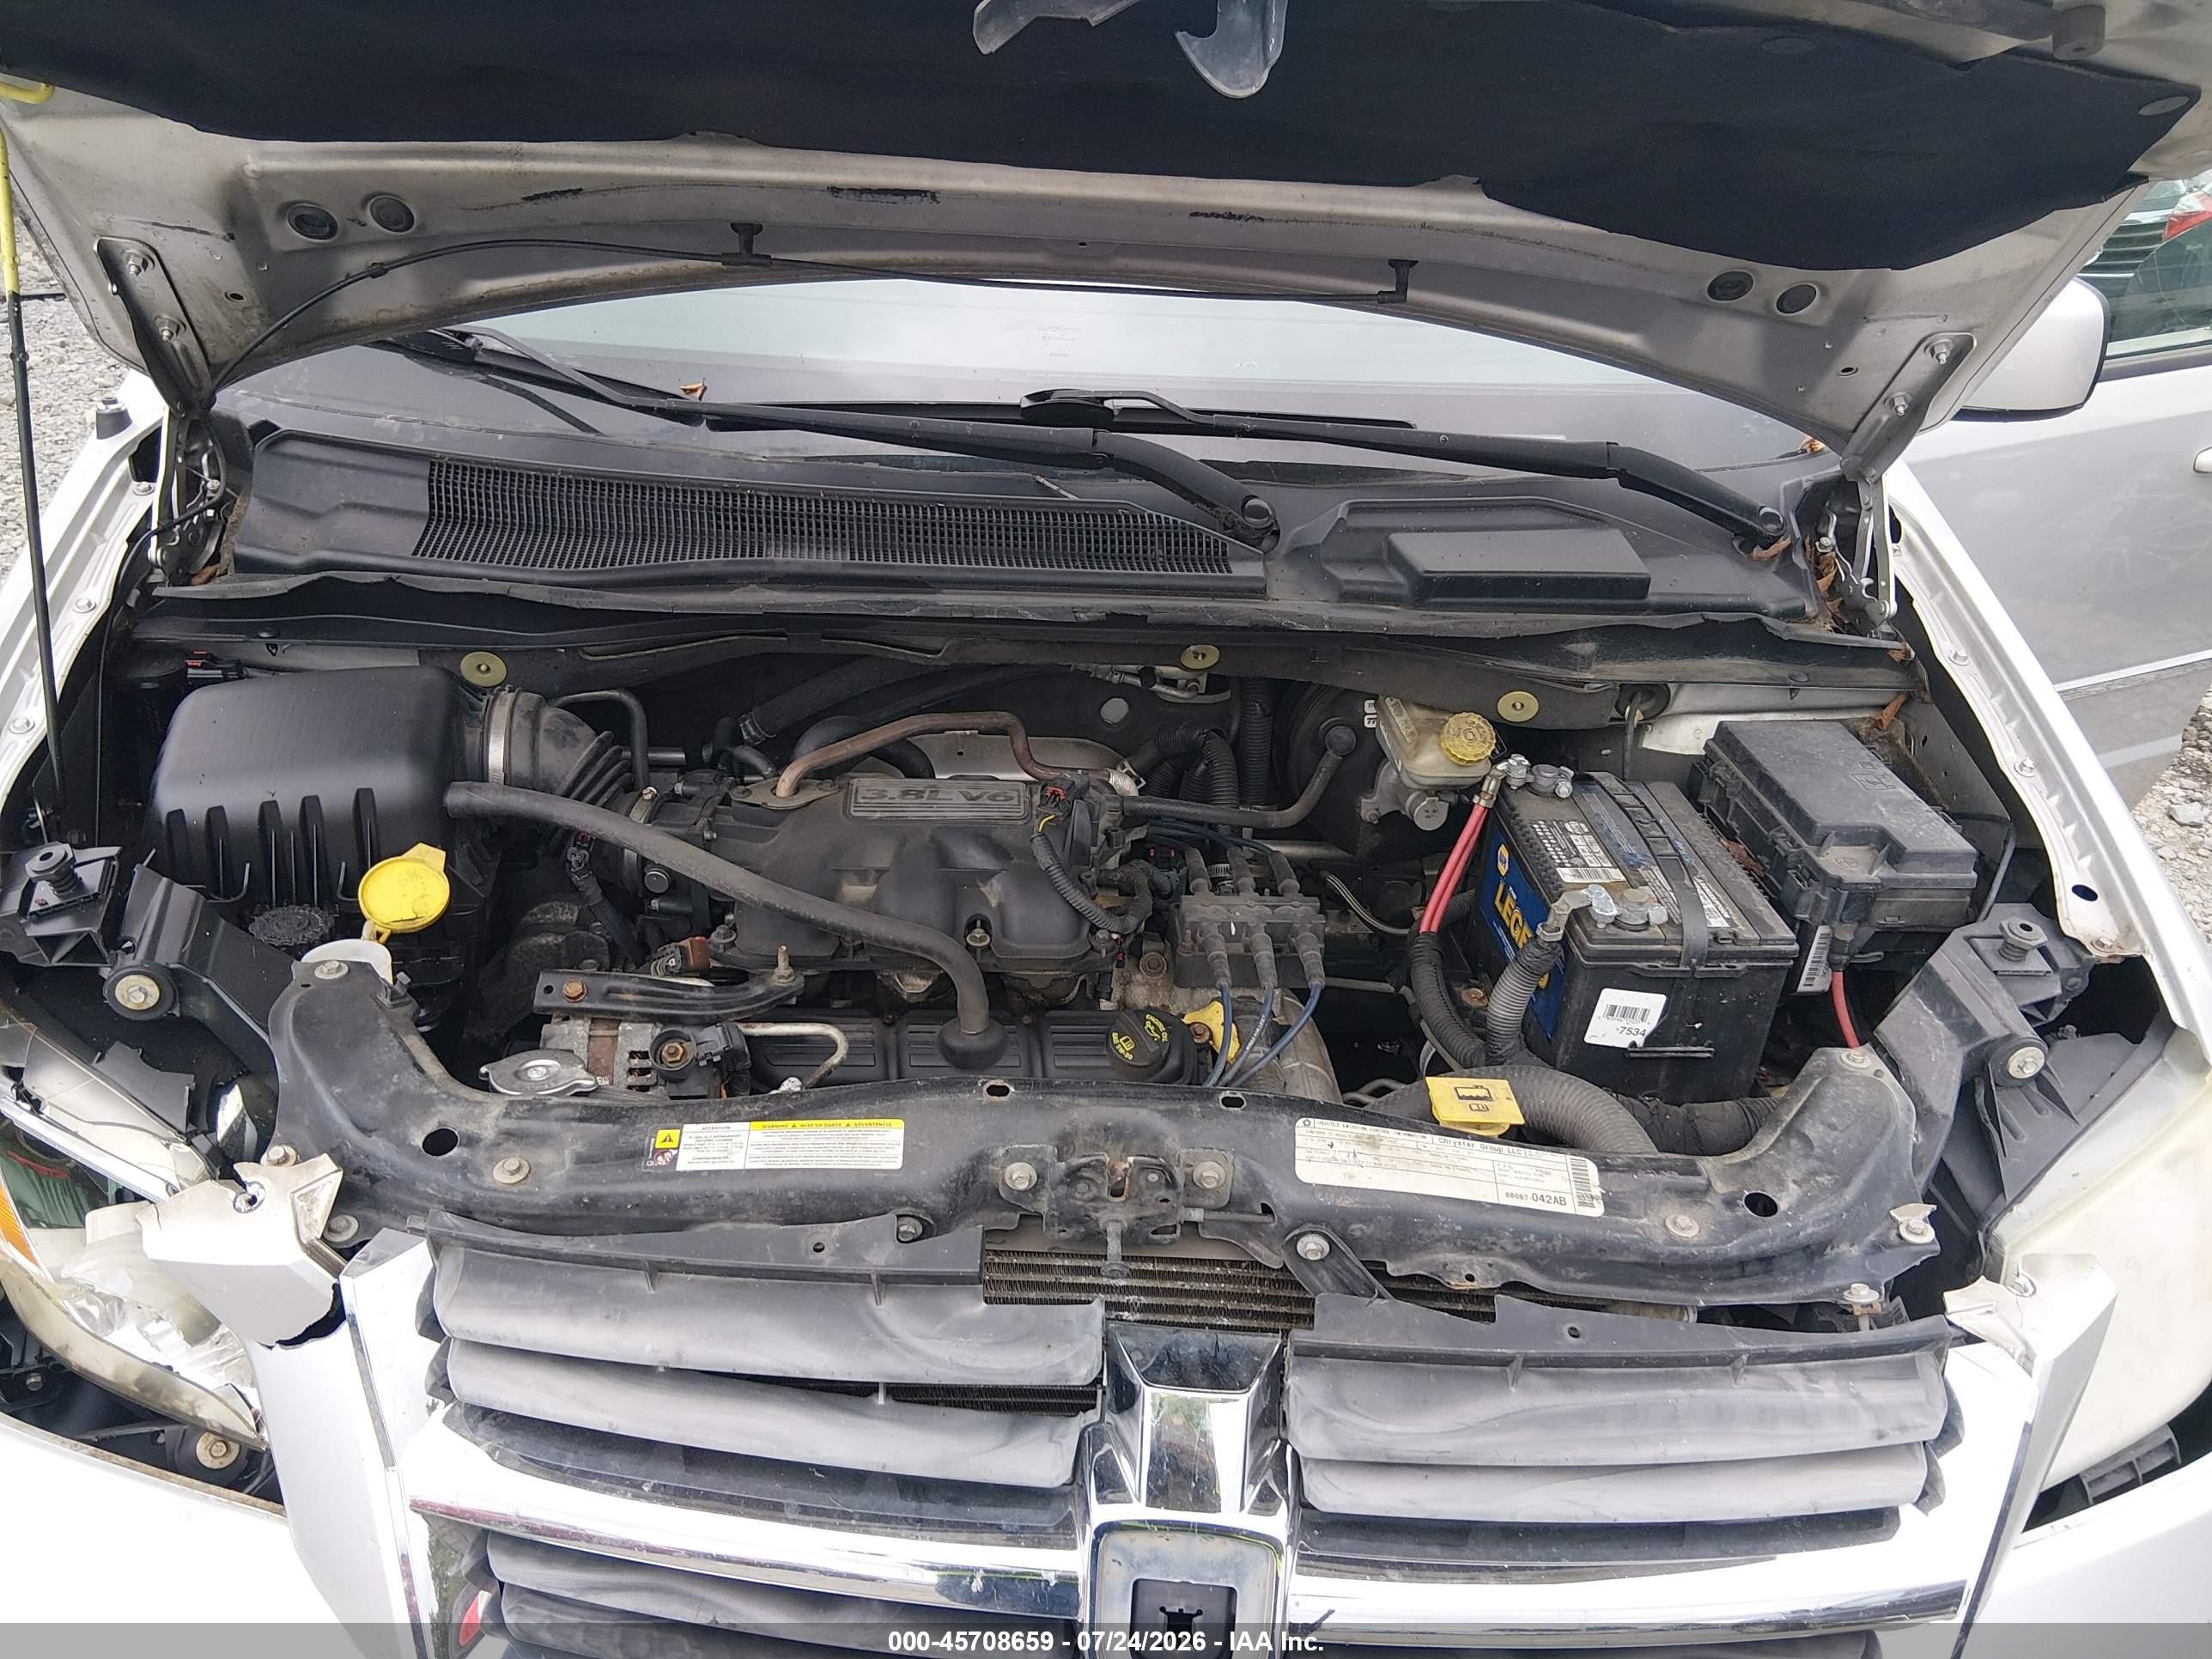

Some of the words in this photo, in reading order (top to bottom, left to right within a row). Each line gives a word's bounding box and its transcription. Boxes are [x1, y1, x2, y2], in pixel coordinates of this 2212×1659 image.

[860, 788, 954, 802] 3.8L
[958, 789, 1016, 802] V6
[1146, 1013, 1166, 1032] ENGINE
[1619, 1026, 1646, 1037] 7534
[1438, 1138, 1474, 1149] Chrysler
[1480, 1143, 1504, 1155] Group
